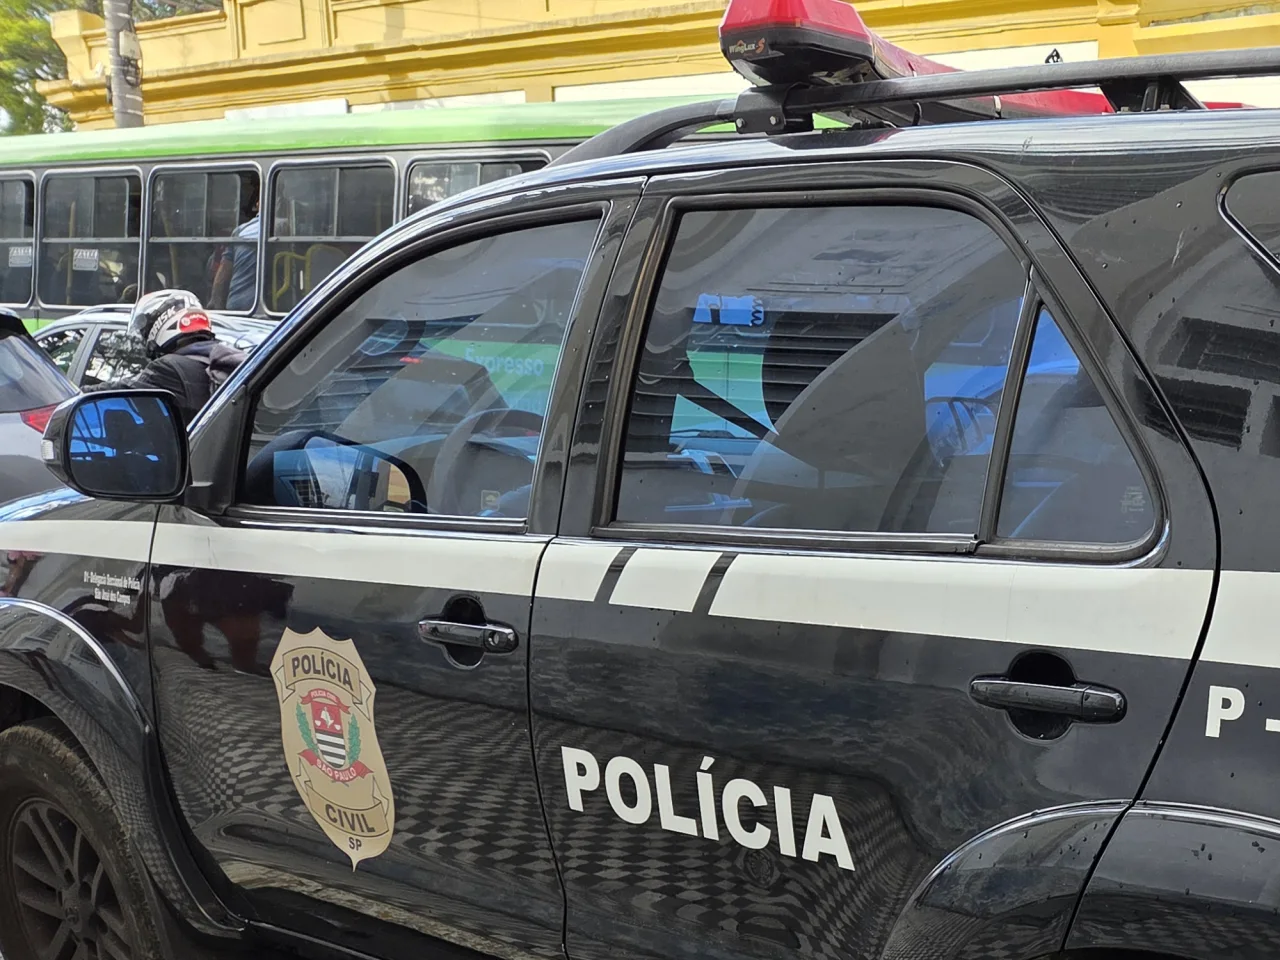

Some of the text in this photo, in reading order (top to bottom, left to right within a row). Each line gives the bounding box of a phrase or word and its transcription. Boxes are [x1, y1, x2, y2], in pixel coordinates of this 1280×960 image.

[291, 652, 354, 691] POLÍCIA
[1205, 685, 1246, 738] P
[334, 767, 357, 781] PAULO
[325, 803, 376, 833] CIVIL
[561, 746, 856, 871] POLÍCIA
[348, 836, 362, 852] SP
